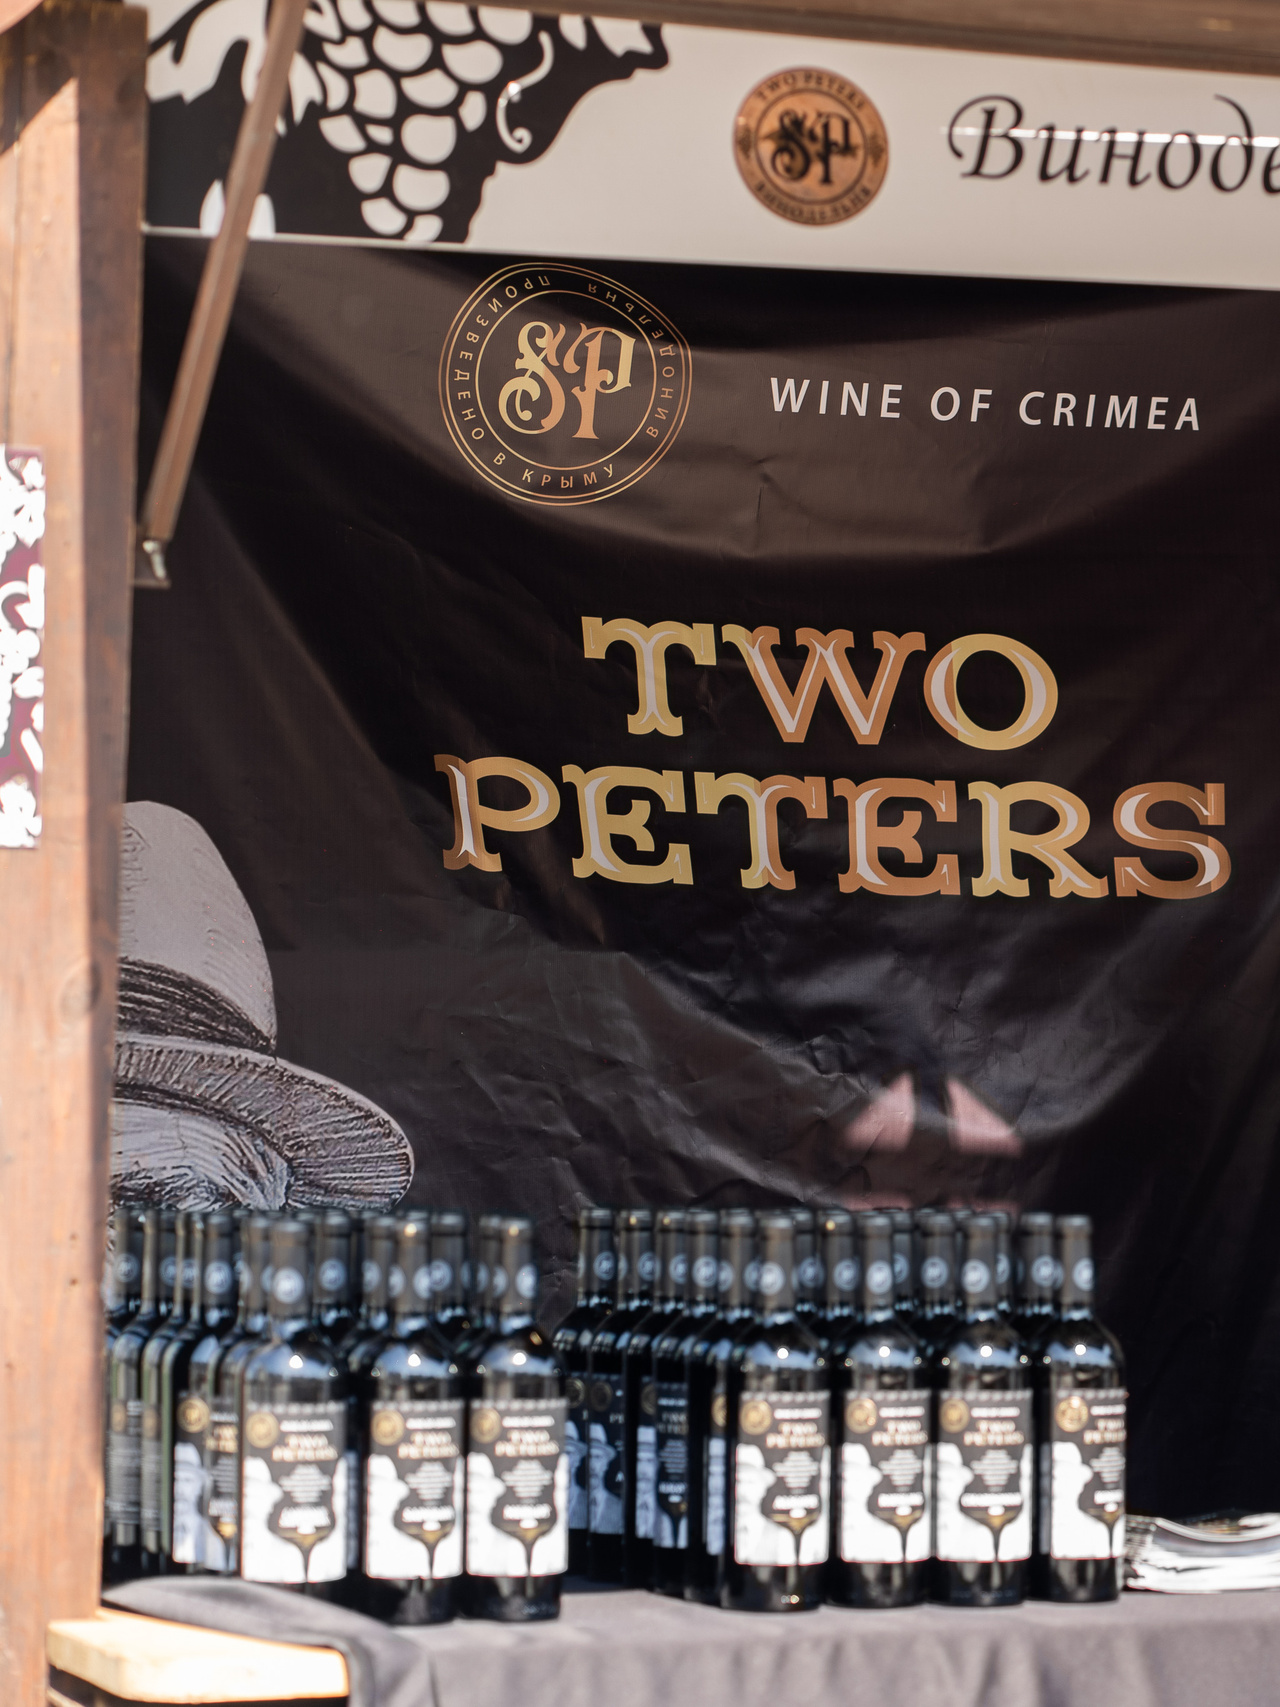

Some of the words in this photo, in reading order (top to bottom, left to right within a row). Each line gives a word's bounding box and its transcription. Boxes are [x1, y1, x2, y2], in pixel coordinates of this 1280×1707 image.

[454, 275, 550, 440] ПРОИЗВЕДЕНО
[770, 376, 902, 419] WINE
[929, 386, 993, 423] OF
[1019, 391, 1201, 431] CRIMEA
[493, 452, 506, 465] В
[522, 463, 614, 489] КРЫМУ
[581, 615, 1059, 751] TWO
[433, 753, 1232, 899] PETERS
